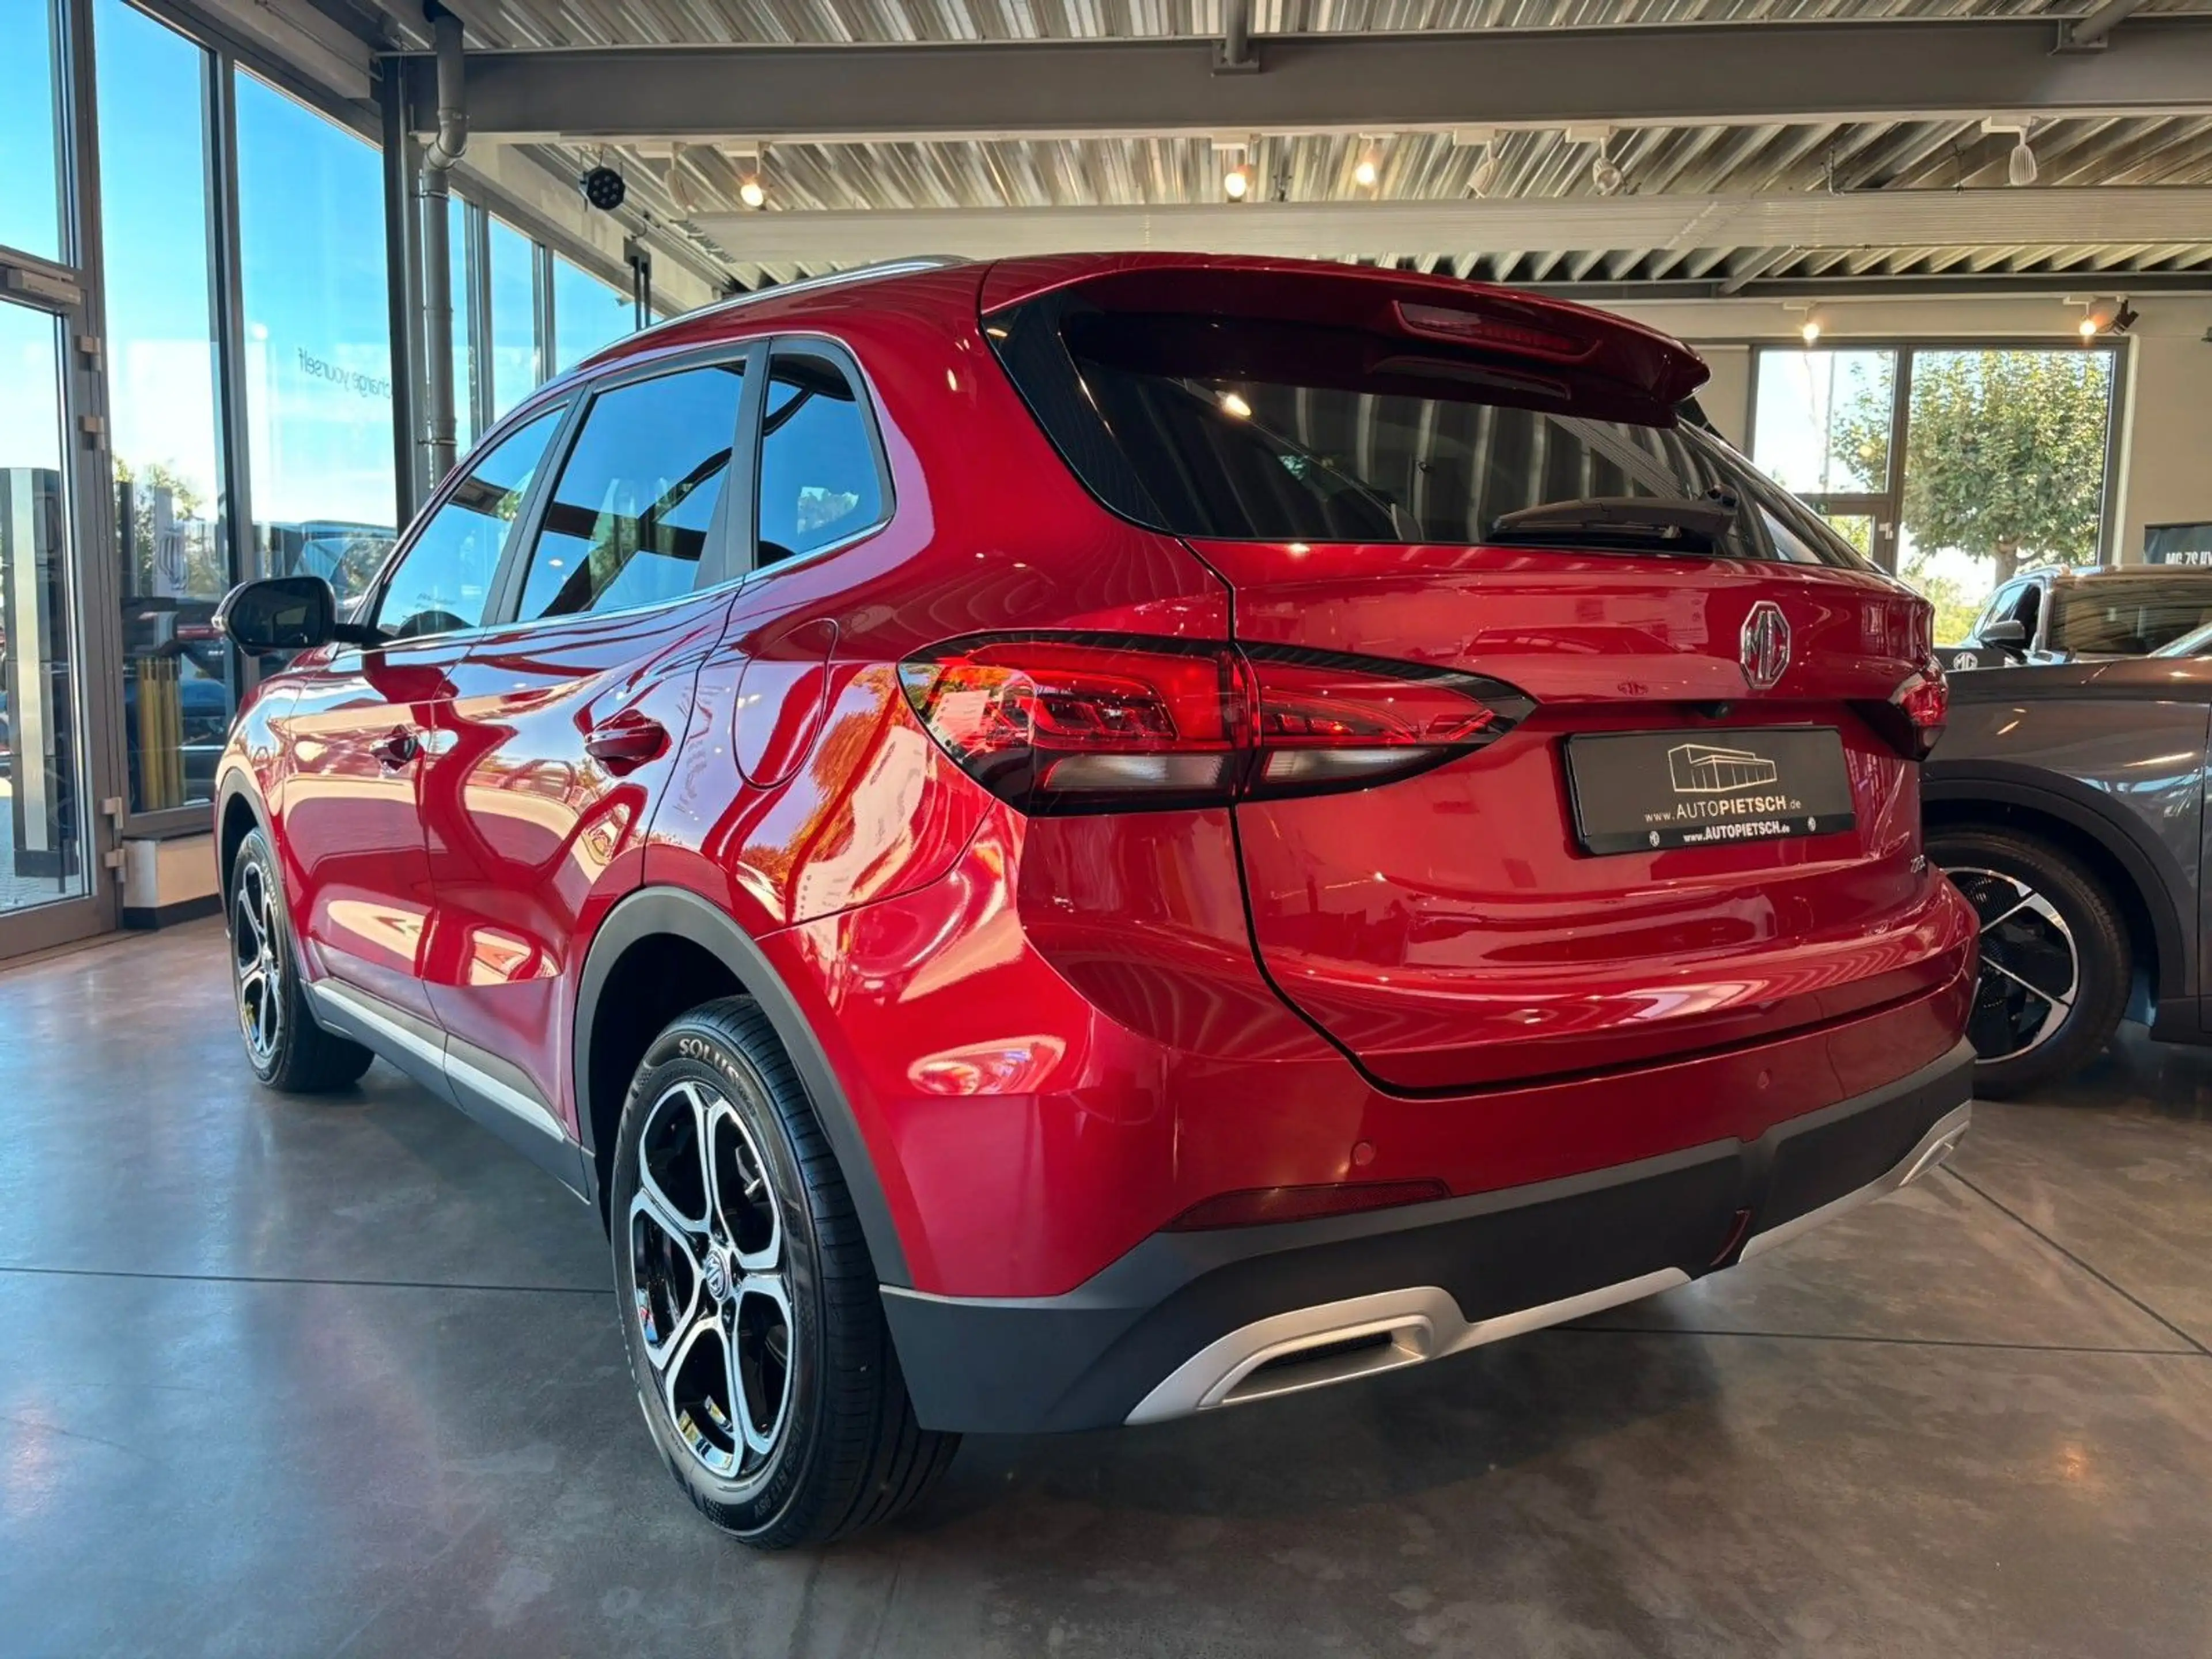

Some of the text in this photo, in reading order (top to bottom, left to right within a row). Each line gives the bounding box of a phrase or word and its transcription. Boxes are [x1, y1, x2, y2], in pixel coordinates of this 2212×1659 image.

[1742, 605, 1788, 684] MG
[1953, 652, 1978, 671] MG
[1683, 821, 1790, 842] www.AUTOPIETSCH.de
[679, 1038, 739, 1085] SOLUS
